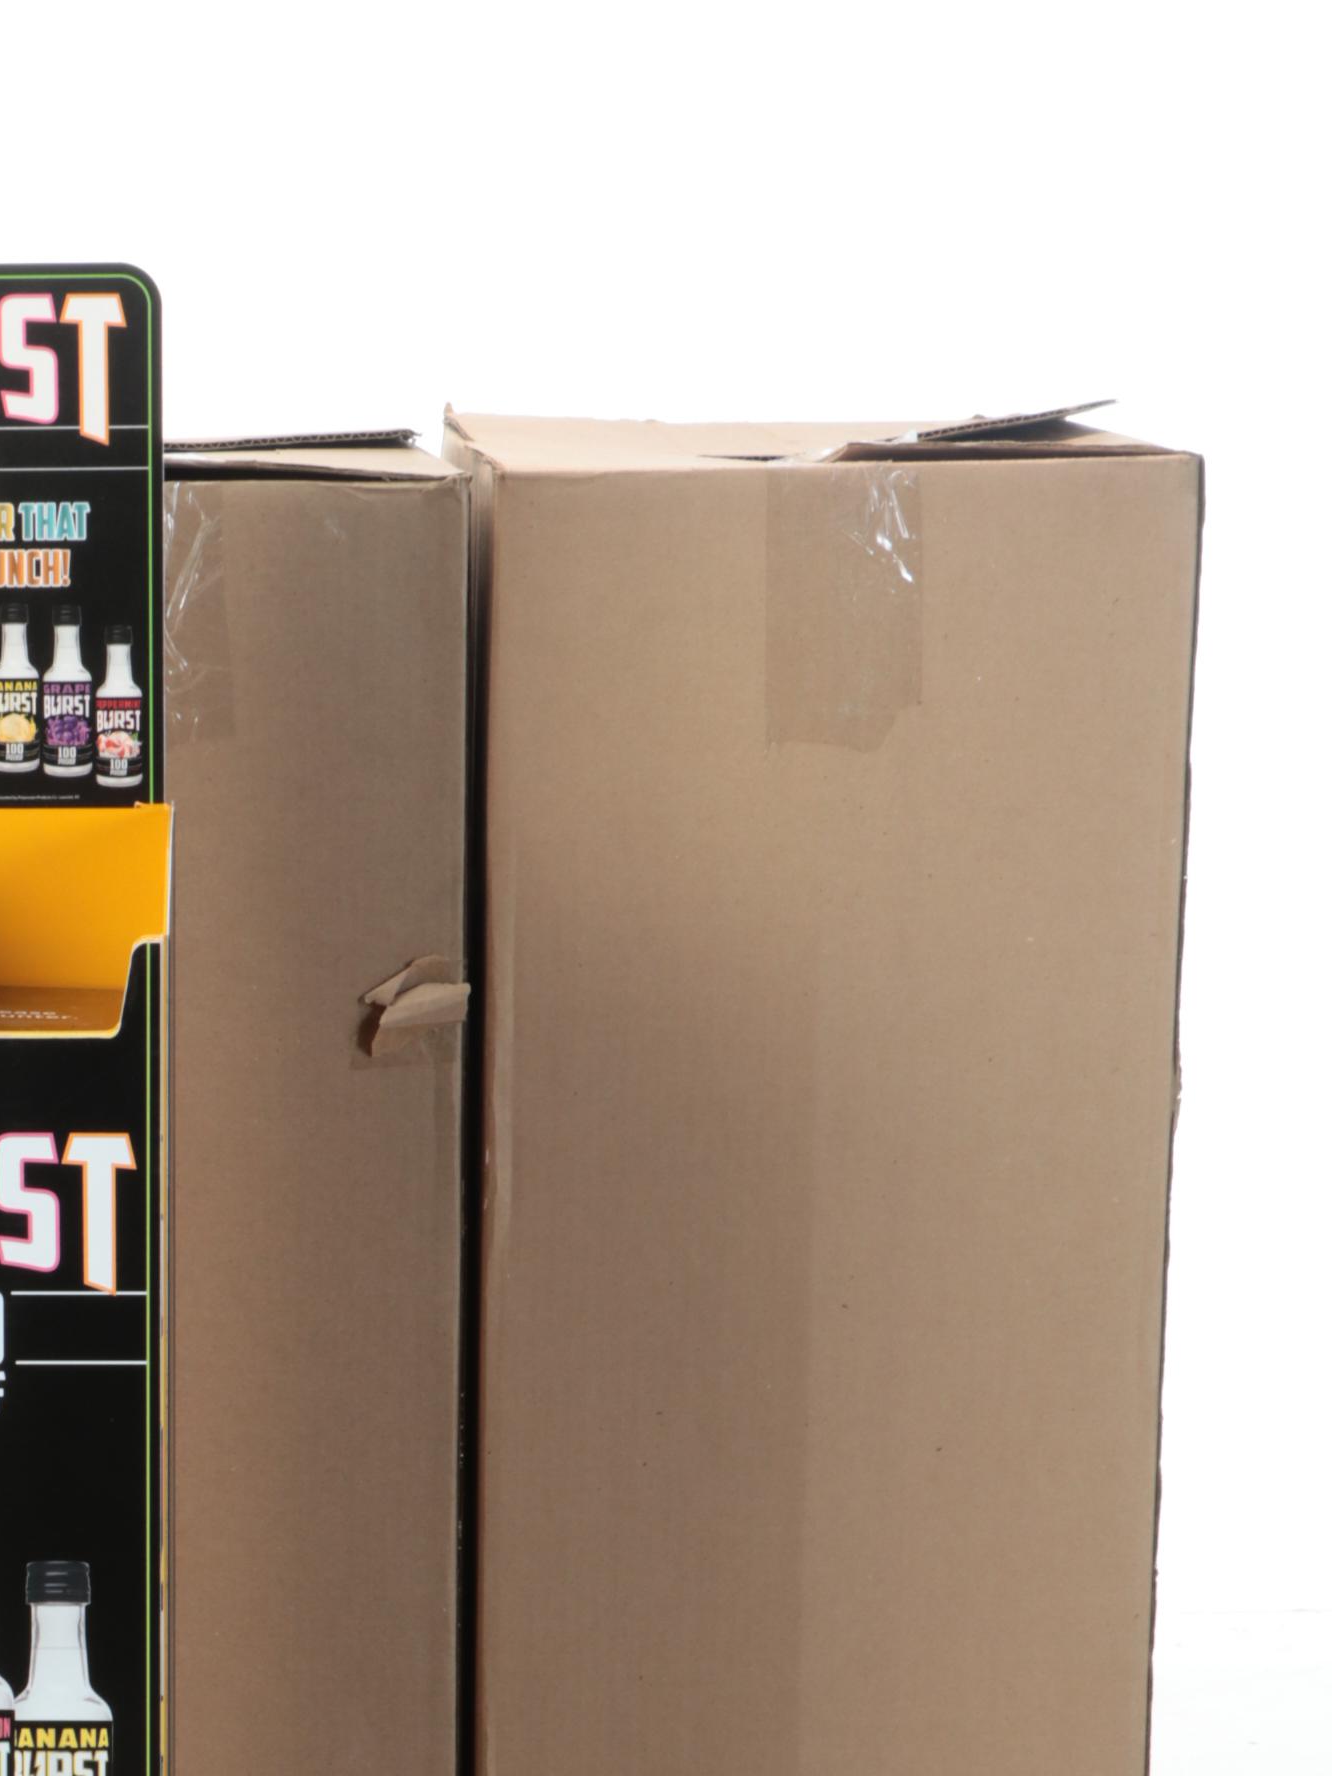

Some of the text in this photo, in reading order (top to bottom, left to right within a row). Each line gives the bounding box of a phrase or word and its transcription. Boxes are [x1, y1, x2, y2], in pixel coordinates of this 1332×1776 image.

[18, 502, 91, 541] THAT
[44, 694, 90, 719] BURST
[97, 709, 140, 733] BURST
[5, 743, 24, 754] 100
[58, 746, 76, 758] 100
[110, 758, 128, 769] 100
[14, 1727, 109, 1748] ANANA
